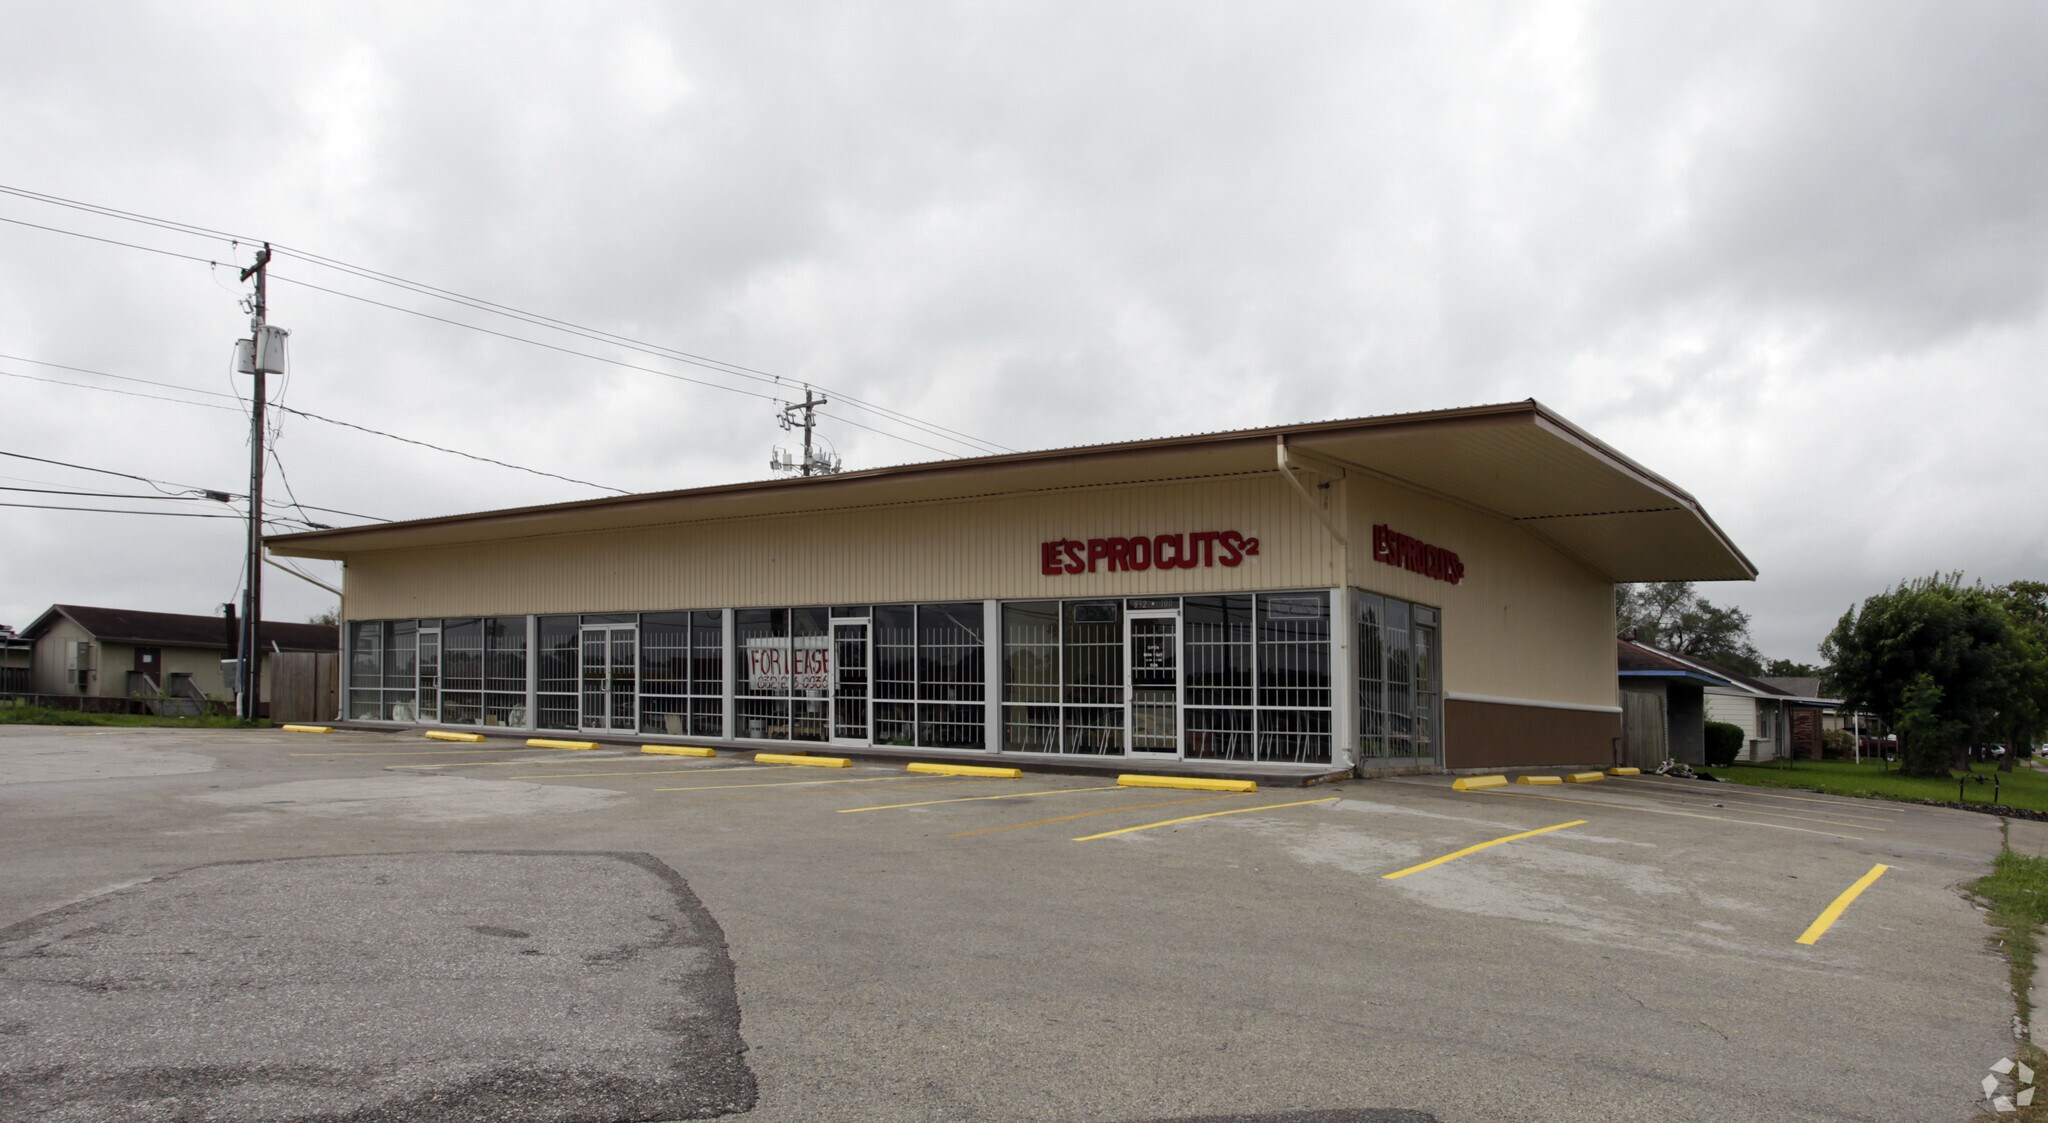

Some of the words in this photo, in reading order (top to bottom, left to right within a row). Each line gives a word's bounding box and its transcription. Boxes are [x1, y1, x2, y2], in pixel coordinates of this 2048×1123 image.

[1087, 536, 1151, 573] PRO
[1153, 531, 1242, 570] CUTS
[751, 648, 781, 675] FOR
[785, 648, 829, 675] LEASE
